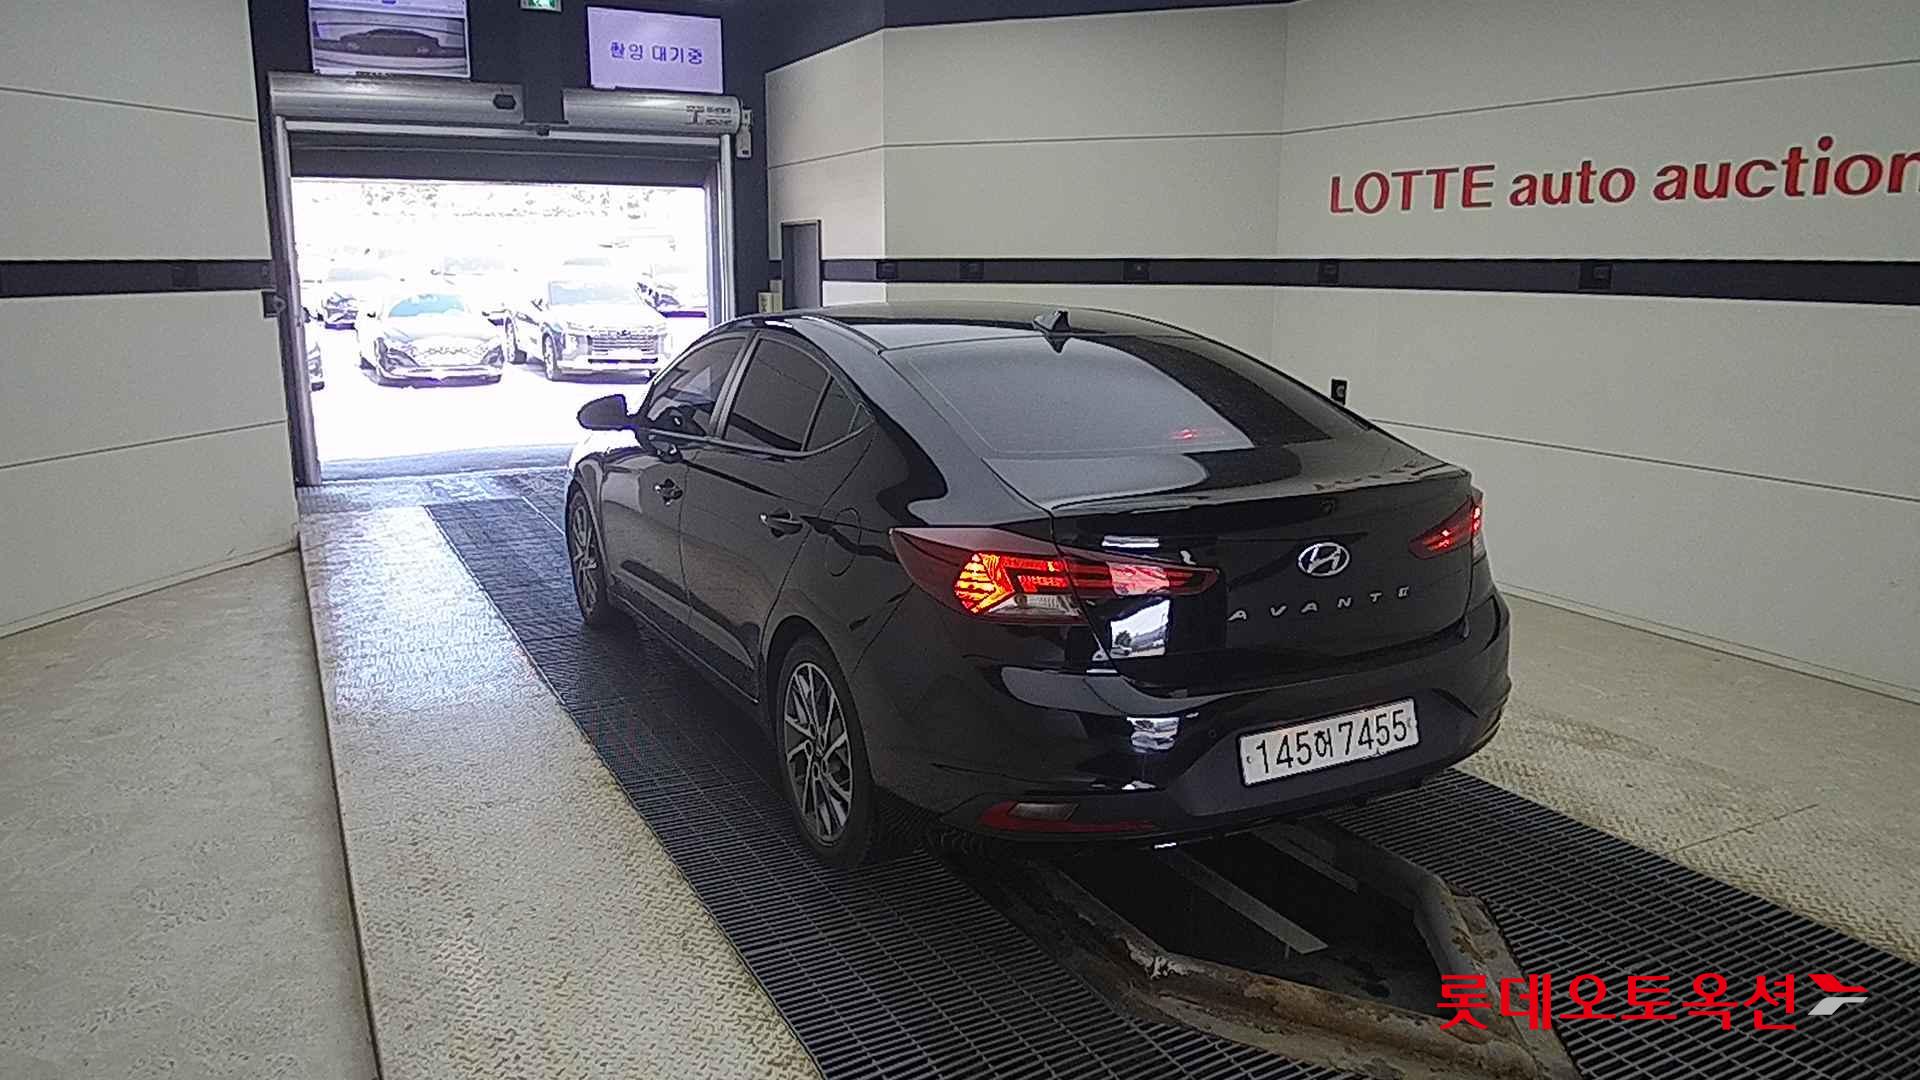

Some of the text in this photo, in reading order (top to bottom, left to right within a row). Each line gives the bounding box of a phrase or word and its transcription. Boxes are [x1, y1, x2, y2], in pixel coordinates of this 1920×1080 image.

[652, 44, 703, 65] 대기중
[1331, 136, 1920, 214] LOTTE auto auction
[1227, 586, 1409, 621] AVANTE
